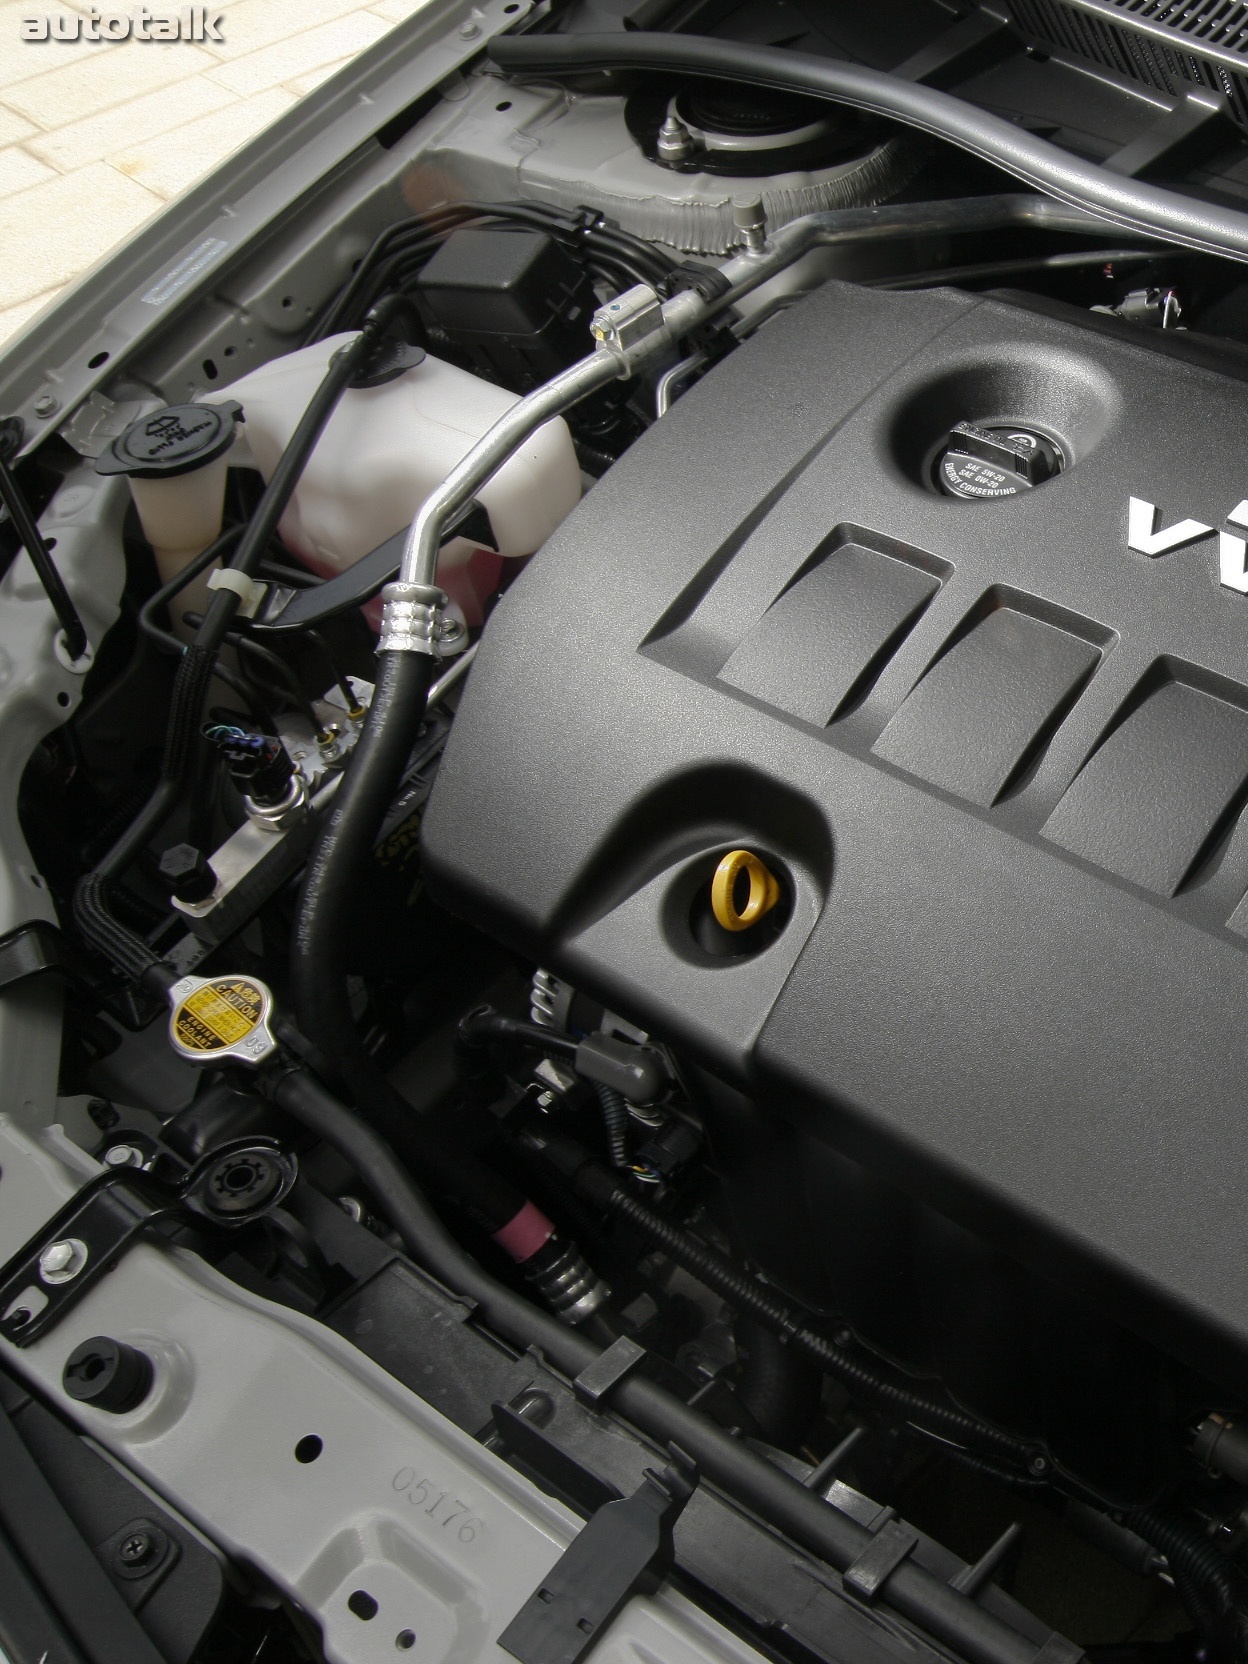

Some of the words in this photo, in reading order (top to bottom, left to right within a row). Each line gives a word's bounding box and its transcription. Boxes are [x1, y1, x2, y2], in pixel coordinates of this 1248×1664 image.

[944, 462, 962, 484] ENERGY
[959, 482, 1017, 496] CONSERVING
[958, 469, 975, 479] SAE
[965, 462, 982, 472] SAE
[215, 984, 259, 1019] CAUTION
[178, 1020, 213, 1048] COOLANT
[186, 1015, 217, 1042] ENGINE
[392, 1465, 485, 1543] 05176
